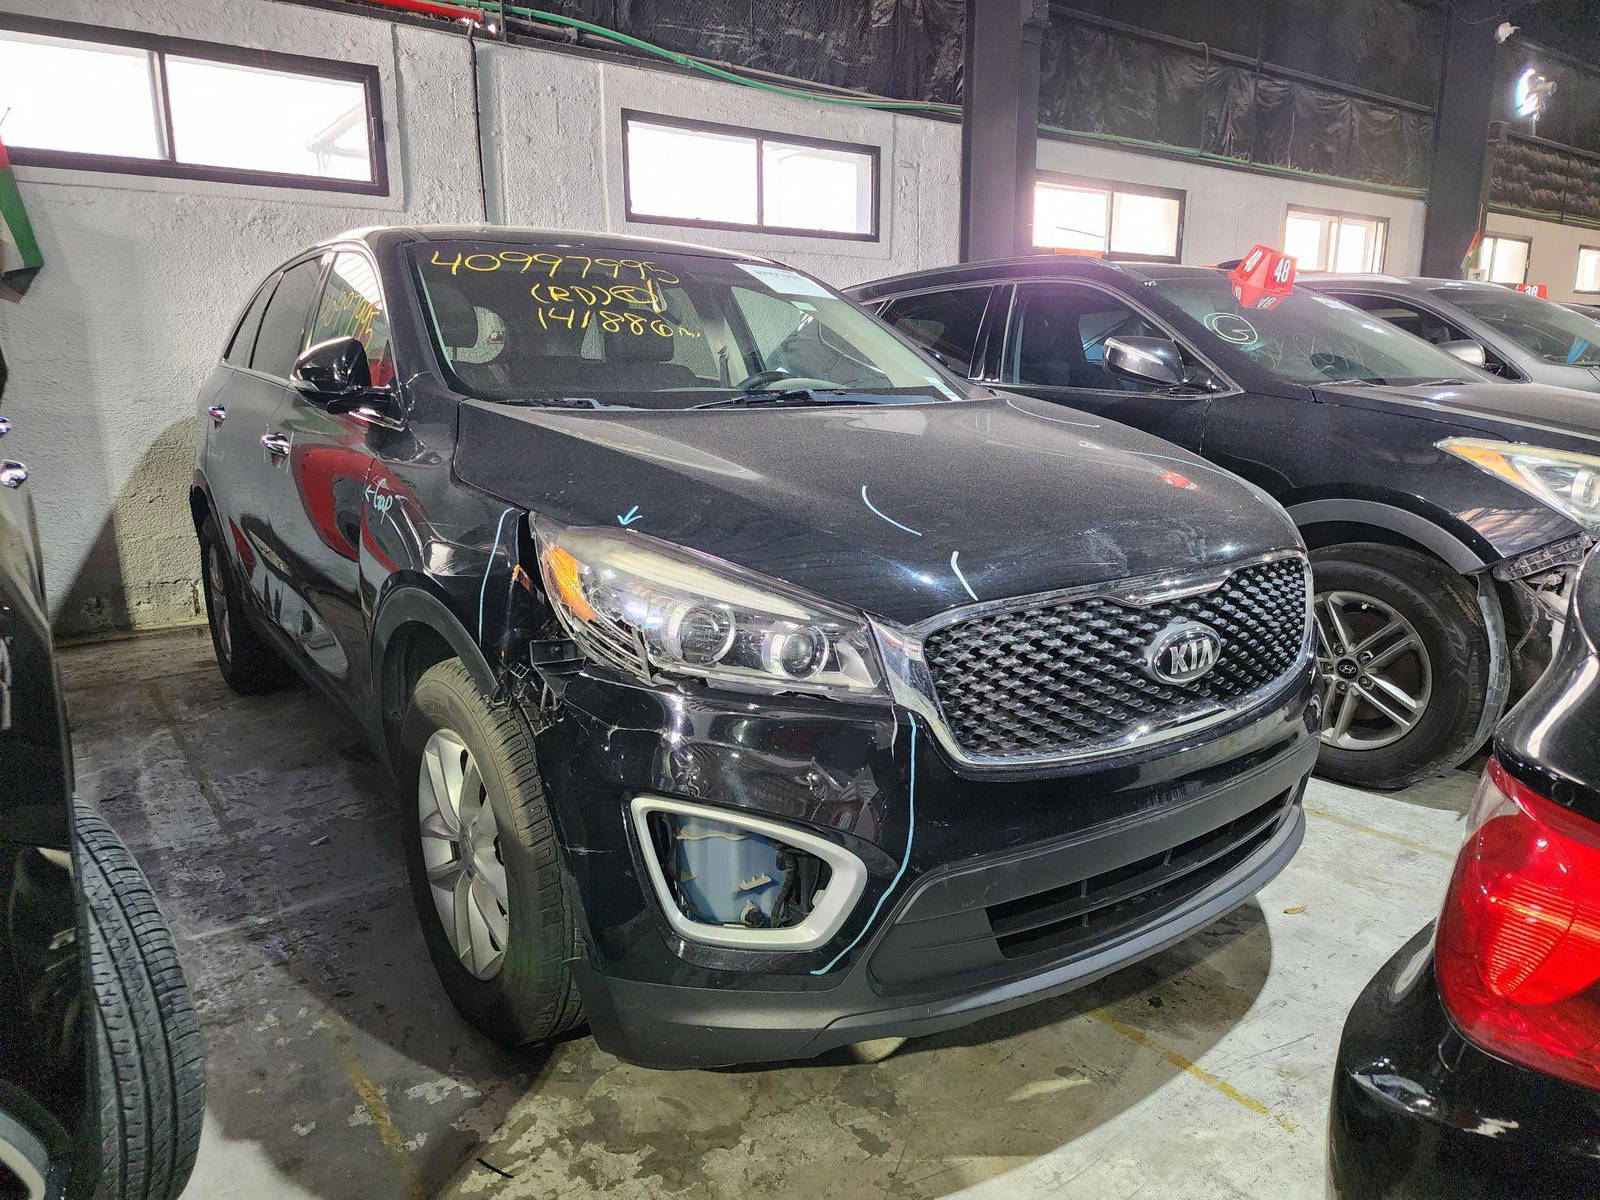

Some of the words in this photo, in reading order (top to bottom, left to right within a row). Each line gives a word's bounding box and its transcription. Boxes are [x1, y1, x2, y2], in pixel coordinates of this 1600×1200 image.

[431, 251, 680, 284] 40997995
[1274, 258, 1291, 283] 48
[1170, 638, 1214, 675] KIA
